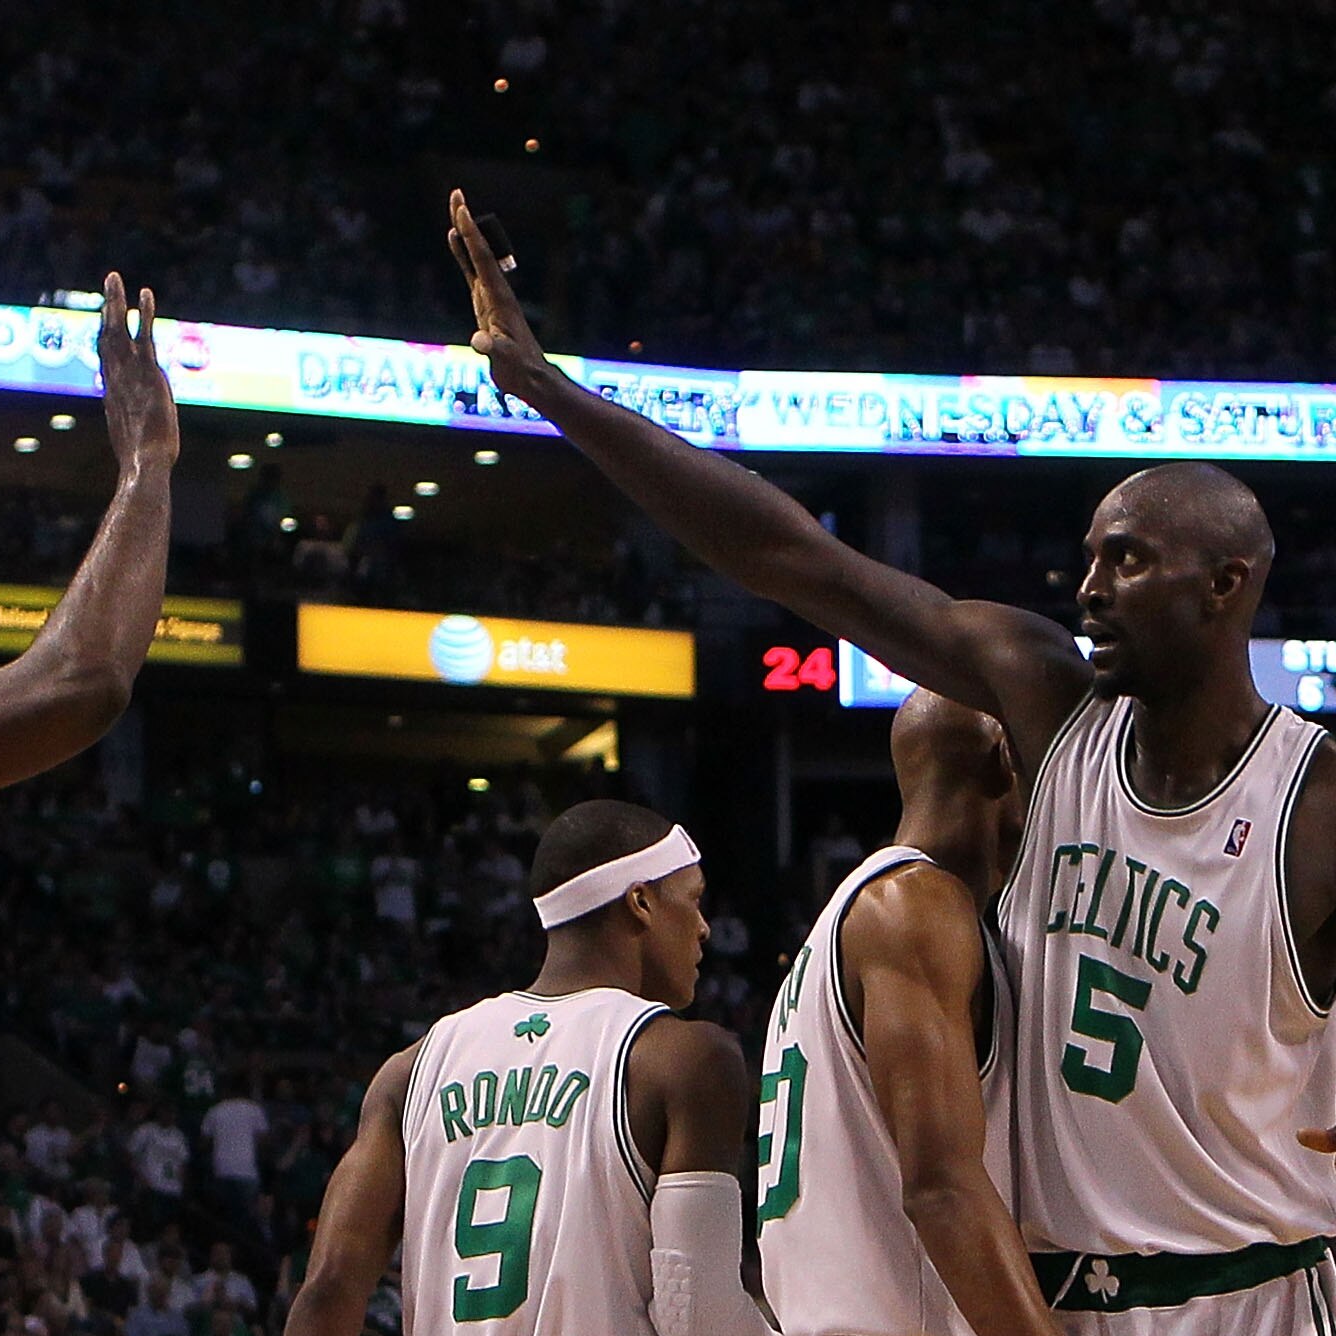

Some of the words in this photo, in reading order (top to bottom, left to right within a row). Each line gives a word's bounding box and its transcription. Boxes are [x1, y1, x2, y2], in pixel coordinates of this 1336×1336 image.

[1120, 390, 1164, 444] &
[498, 638, 567, 673] at&t
[764, 647, 837, 690] 24
[1046, 843, 1221, 995] CELTICS
[1060, 953, 1153, 1104] 5
[440, 1064, 591, 1143] RONDO
[452, 1154, 543, 1323] 9
